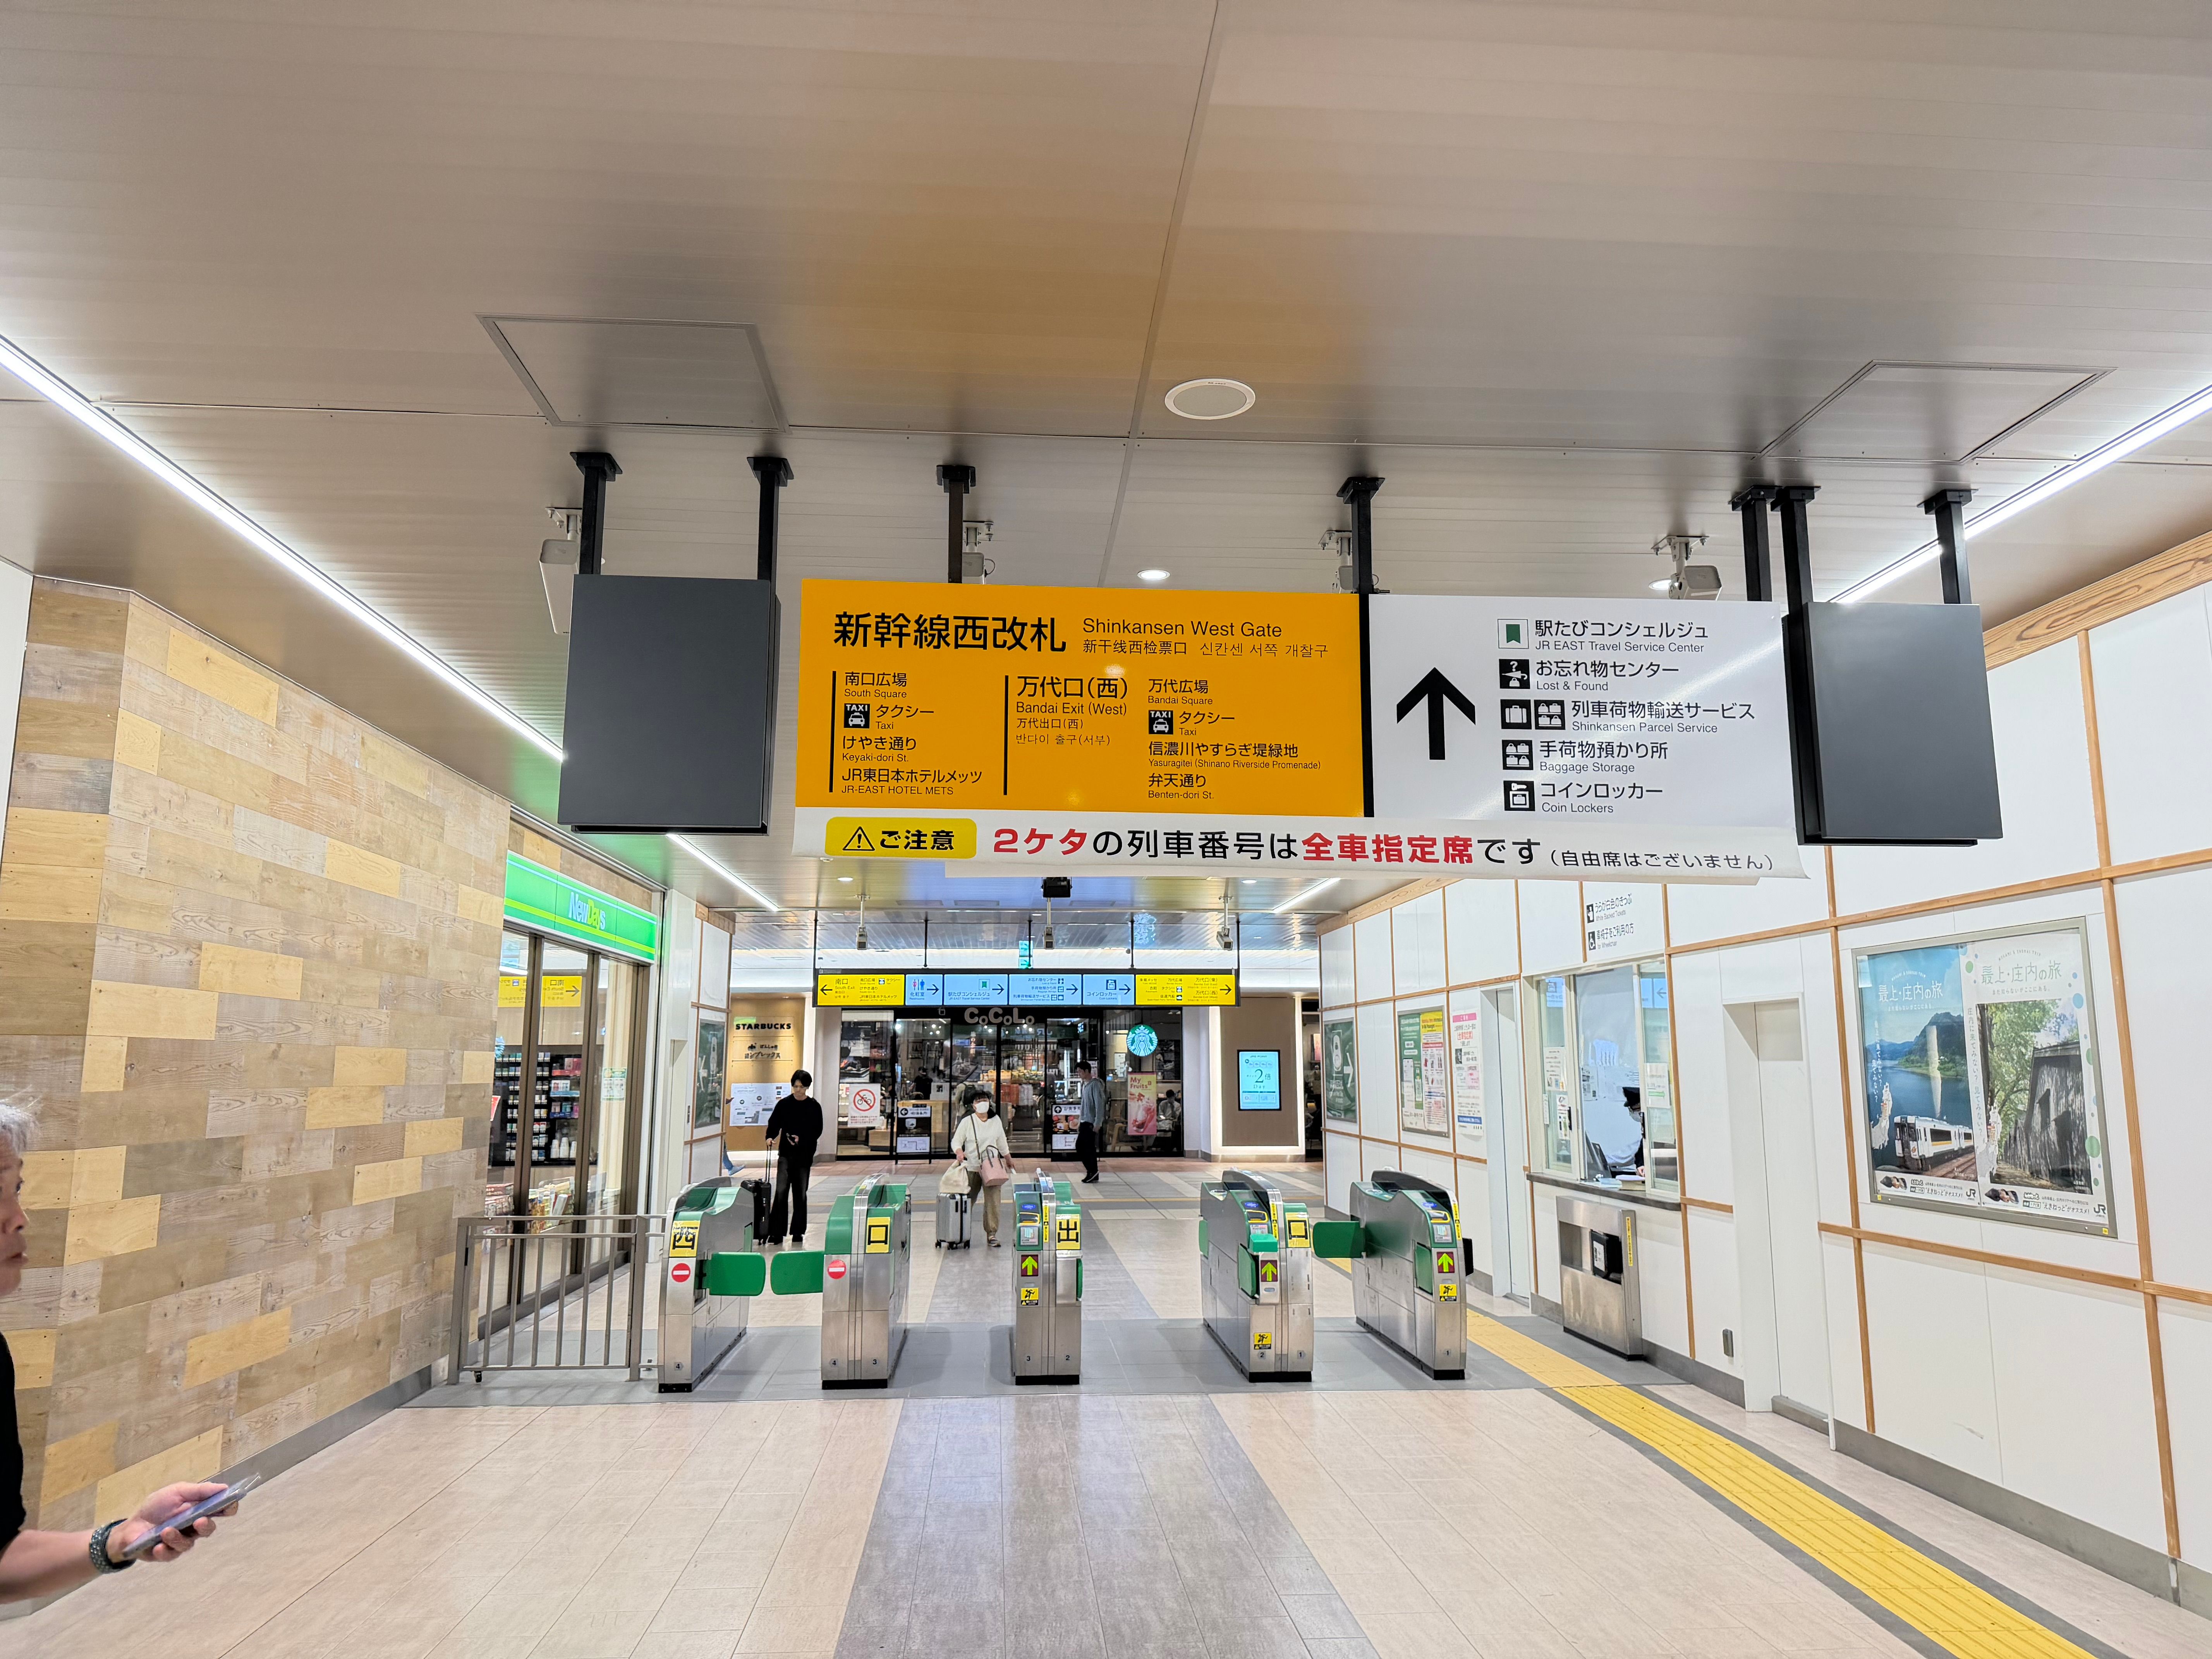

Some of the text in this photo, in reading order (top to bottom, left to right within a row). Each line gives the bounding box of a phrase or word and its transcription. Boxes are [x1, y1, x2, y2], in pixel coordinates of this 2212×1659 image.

[833, 611, 1066, 652] 新幹線西改札
[1083, 618, 1282, 637] Shinkansen West Gate
[1535, 620, 1708, 638] 駅たびコンシェルジュ
[1083, 639, 1187, 655] 新干线西检票口
[1200, 642, 1328, 658] 신칸센 서쪽 개찰구
[1535, 640, 1704, 652] JR EAST Travel Service Center
[1536, 659, 1679, 678] お忘れ物センター
[845, 671, 907, 687] 南口広場
[1149, 678, 1209, 694] 万代広場
[1537, 680, 1608, 691] Lost & Found
[844, 688, 907, 700] South Square
[1148, 696, 1213, 706] Bandai Square
[876, 704, 934, 718] タクシー
[1016, 701, 1127, 716] Bandai Exit (West)
[1571, 700, 1755, 719] 列車荷物輸送サービス
[875, 721, 894, 730] Taxi
[1179, 711, 1235, 725] タクシー
[1179, 728, 1196, 736] Taxi
[1572, 721, 1717, 733] Shinkansen Parcel Service
[843, 735, 916, 750] けやき通り
[1016, 733, 1110, 746] 반다이 출구(서부)
[1149, 741, 1298, 758] 信濃川やすらぎ堤緑地
[1539, 740, 1668, 759] 手荷物預かり所
[842, 752, 909, 763] Keyaki-dori St.
[1149, 758, 1321, 770] Yasuragitei (Shinano Riverside Promenade)
[842, 768, 982, 783] JR東日本ホテルメッツ
[1540, 761, 1635, 775] Baggage Storage
[1148, 773, 1206, 788] 弁天通り
[842, 785, 953, 795] JR-EAST HOTEL METS
[1148, 790, 1214, 799] Benten-dori St.
[1541, 782, 1663, 799] コインロッカー
[1542, 802, 1614, 813] Coin Lockers
[878, 829, 956, 852] ご注意
[993, 828, 1542, 866] 2ケタの列車番号は全車指定席です
[568, 892, 606, 930] NewDays
[1981, 960, 2062, 985] 最上・庄内の旅
[1879, 981, 1943, 1002] 最上・庄内の旅
[964, 1008, 1034, 1025] CoCoLo
[1255, 1069, 1264, 1083] 2
[1966, 1188, 1976, 1198] JR
[2094, 1204, 2106, 1214] JR
[1058, 1219, 1079, 1243] 出
